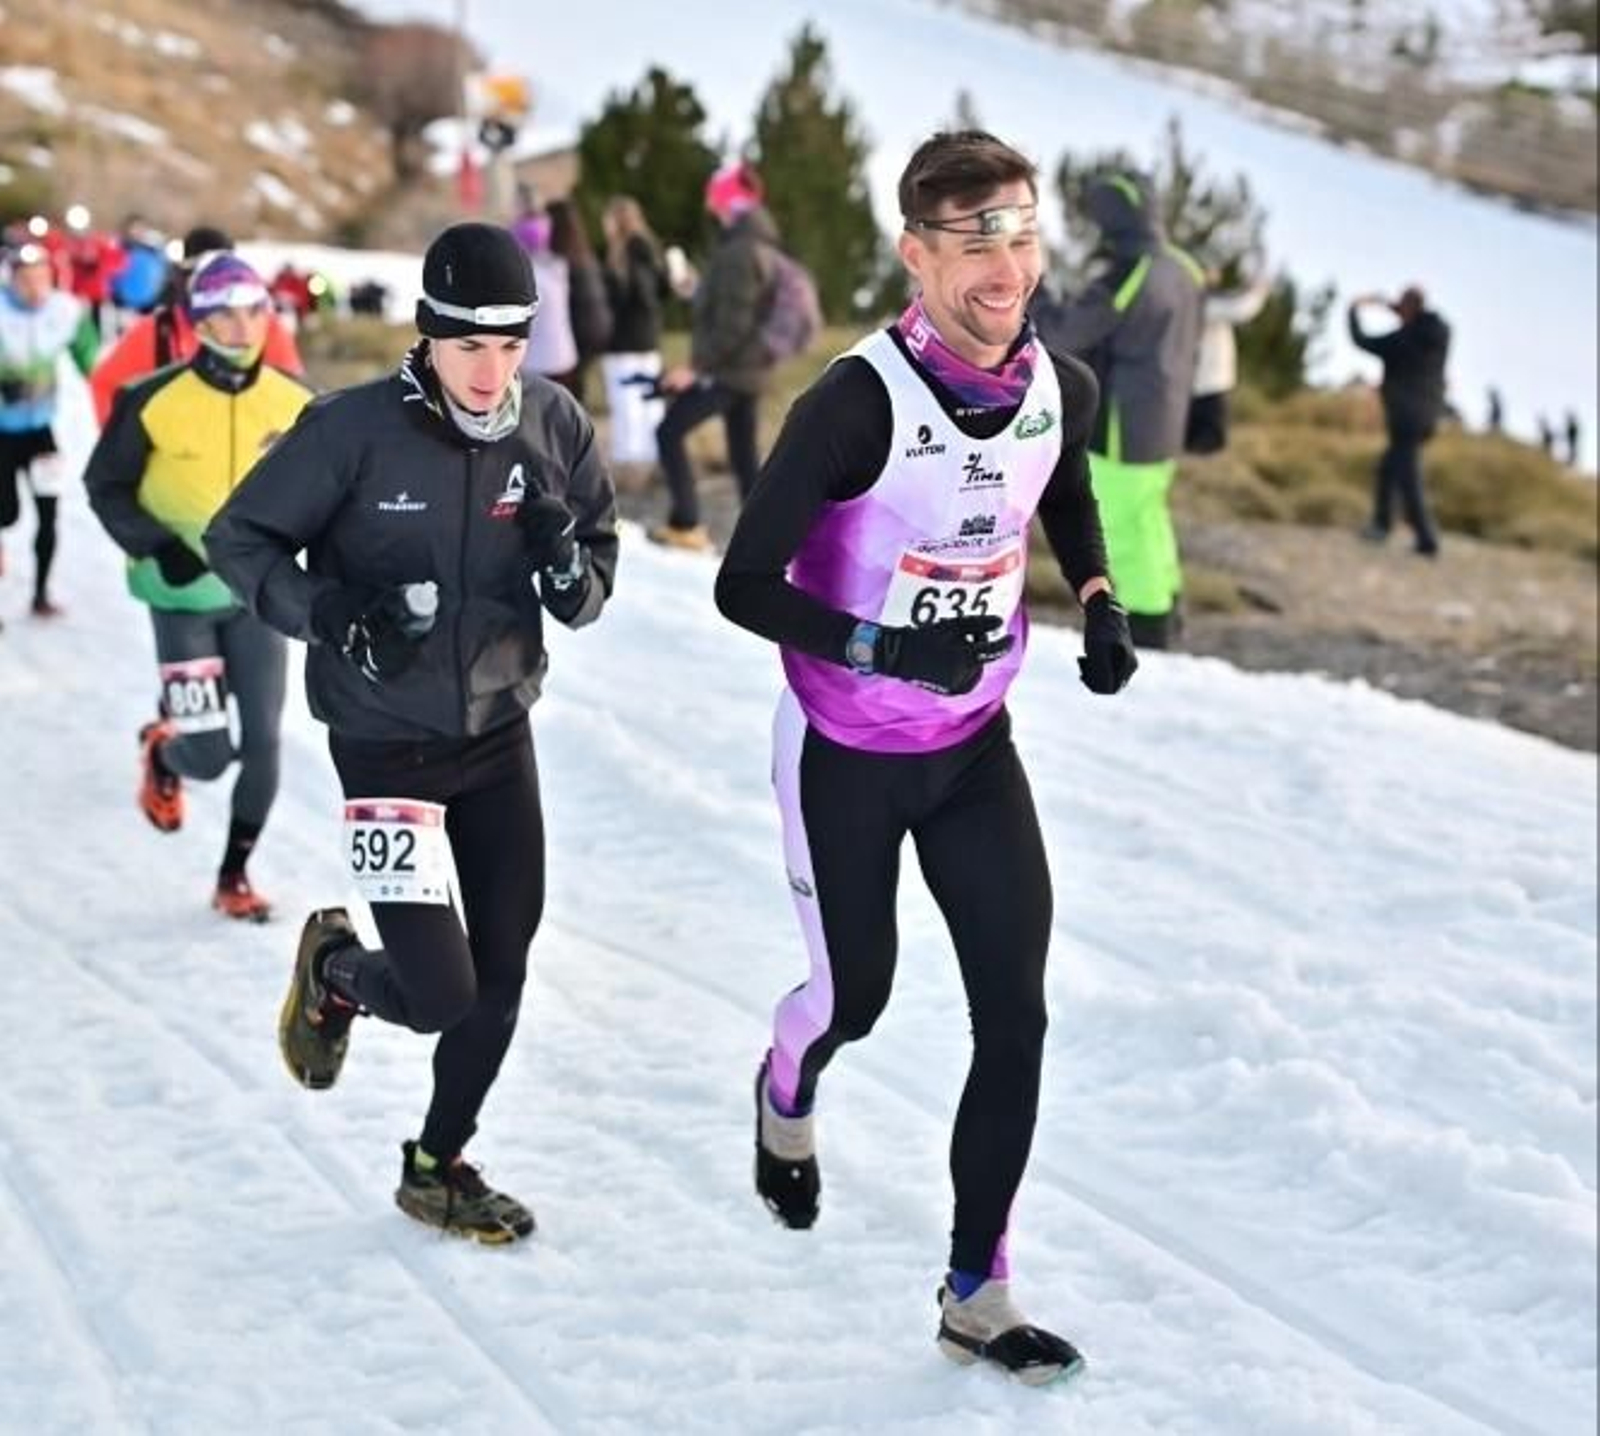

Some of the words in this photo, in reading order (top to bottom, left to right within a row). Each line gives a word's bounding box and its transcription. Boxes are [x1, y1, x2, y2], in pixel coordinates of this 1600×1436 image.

[911, 586, 993, 630] 635
[168, 677, 220, 717] 801
[351, 828, 416, 873] 592
